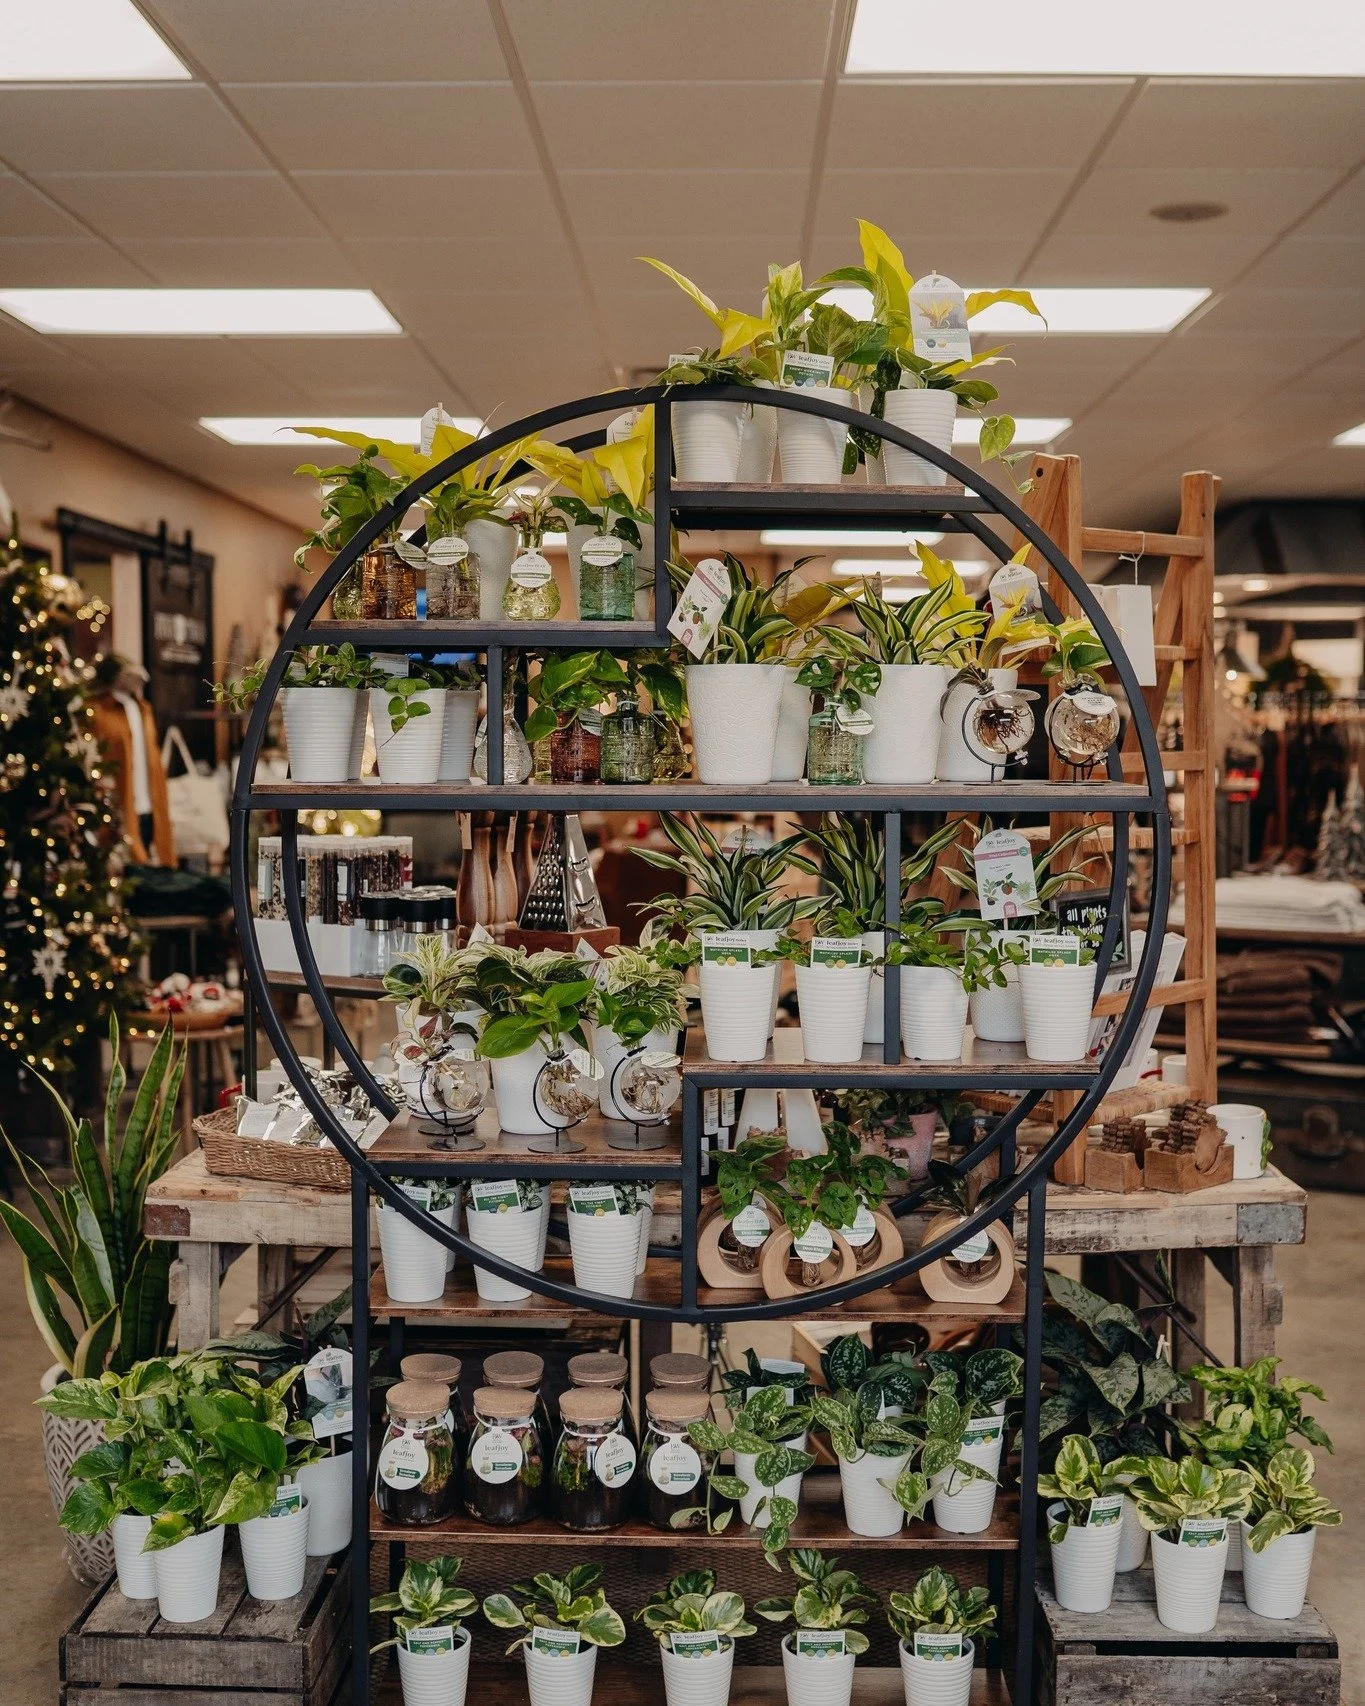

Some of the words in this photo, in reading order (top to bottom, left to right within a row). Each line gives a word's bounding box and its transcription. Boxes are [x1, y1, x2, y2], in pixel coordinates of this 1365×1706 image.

[1067, 908, 1078, 922] all
[393, 1449, 415, 1459] leafjoy
[606, 1448, 624, 1458] leafjoy
[663, 1454, 687, 1462] leafjoy
